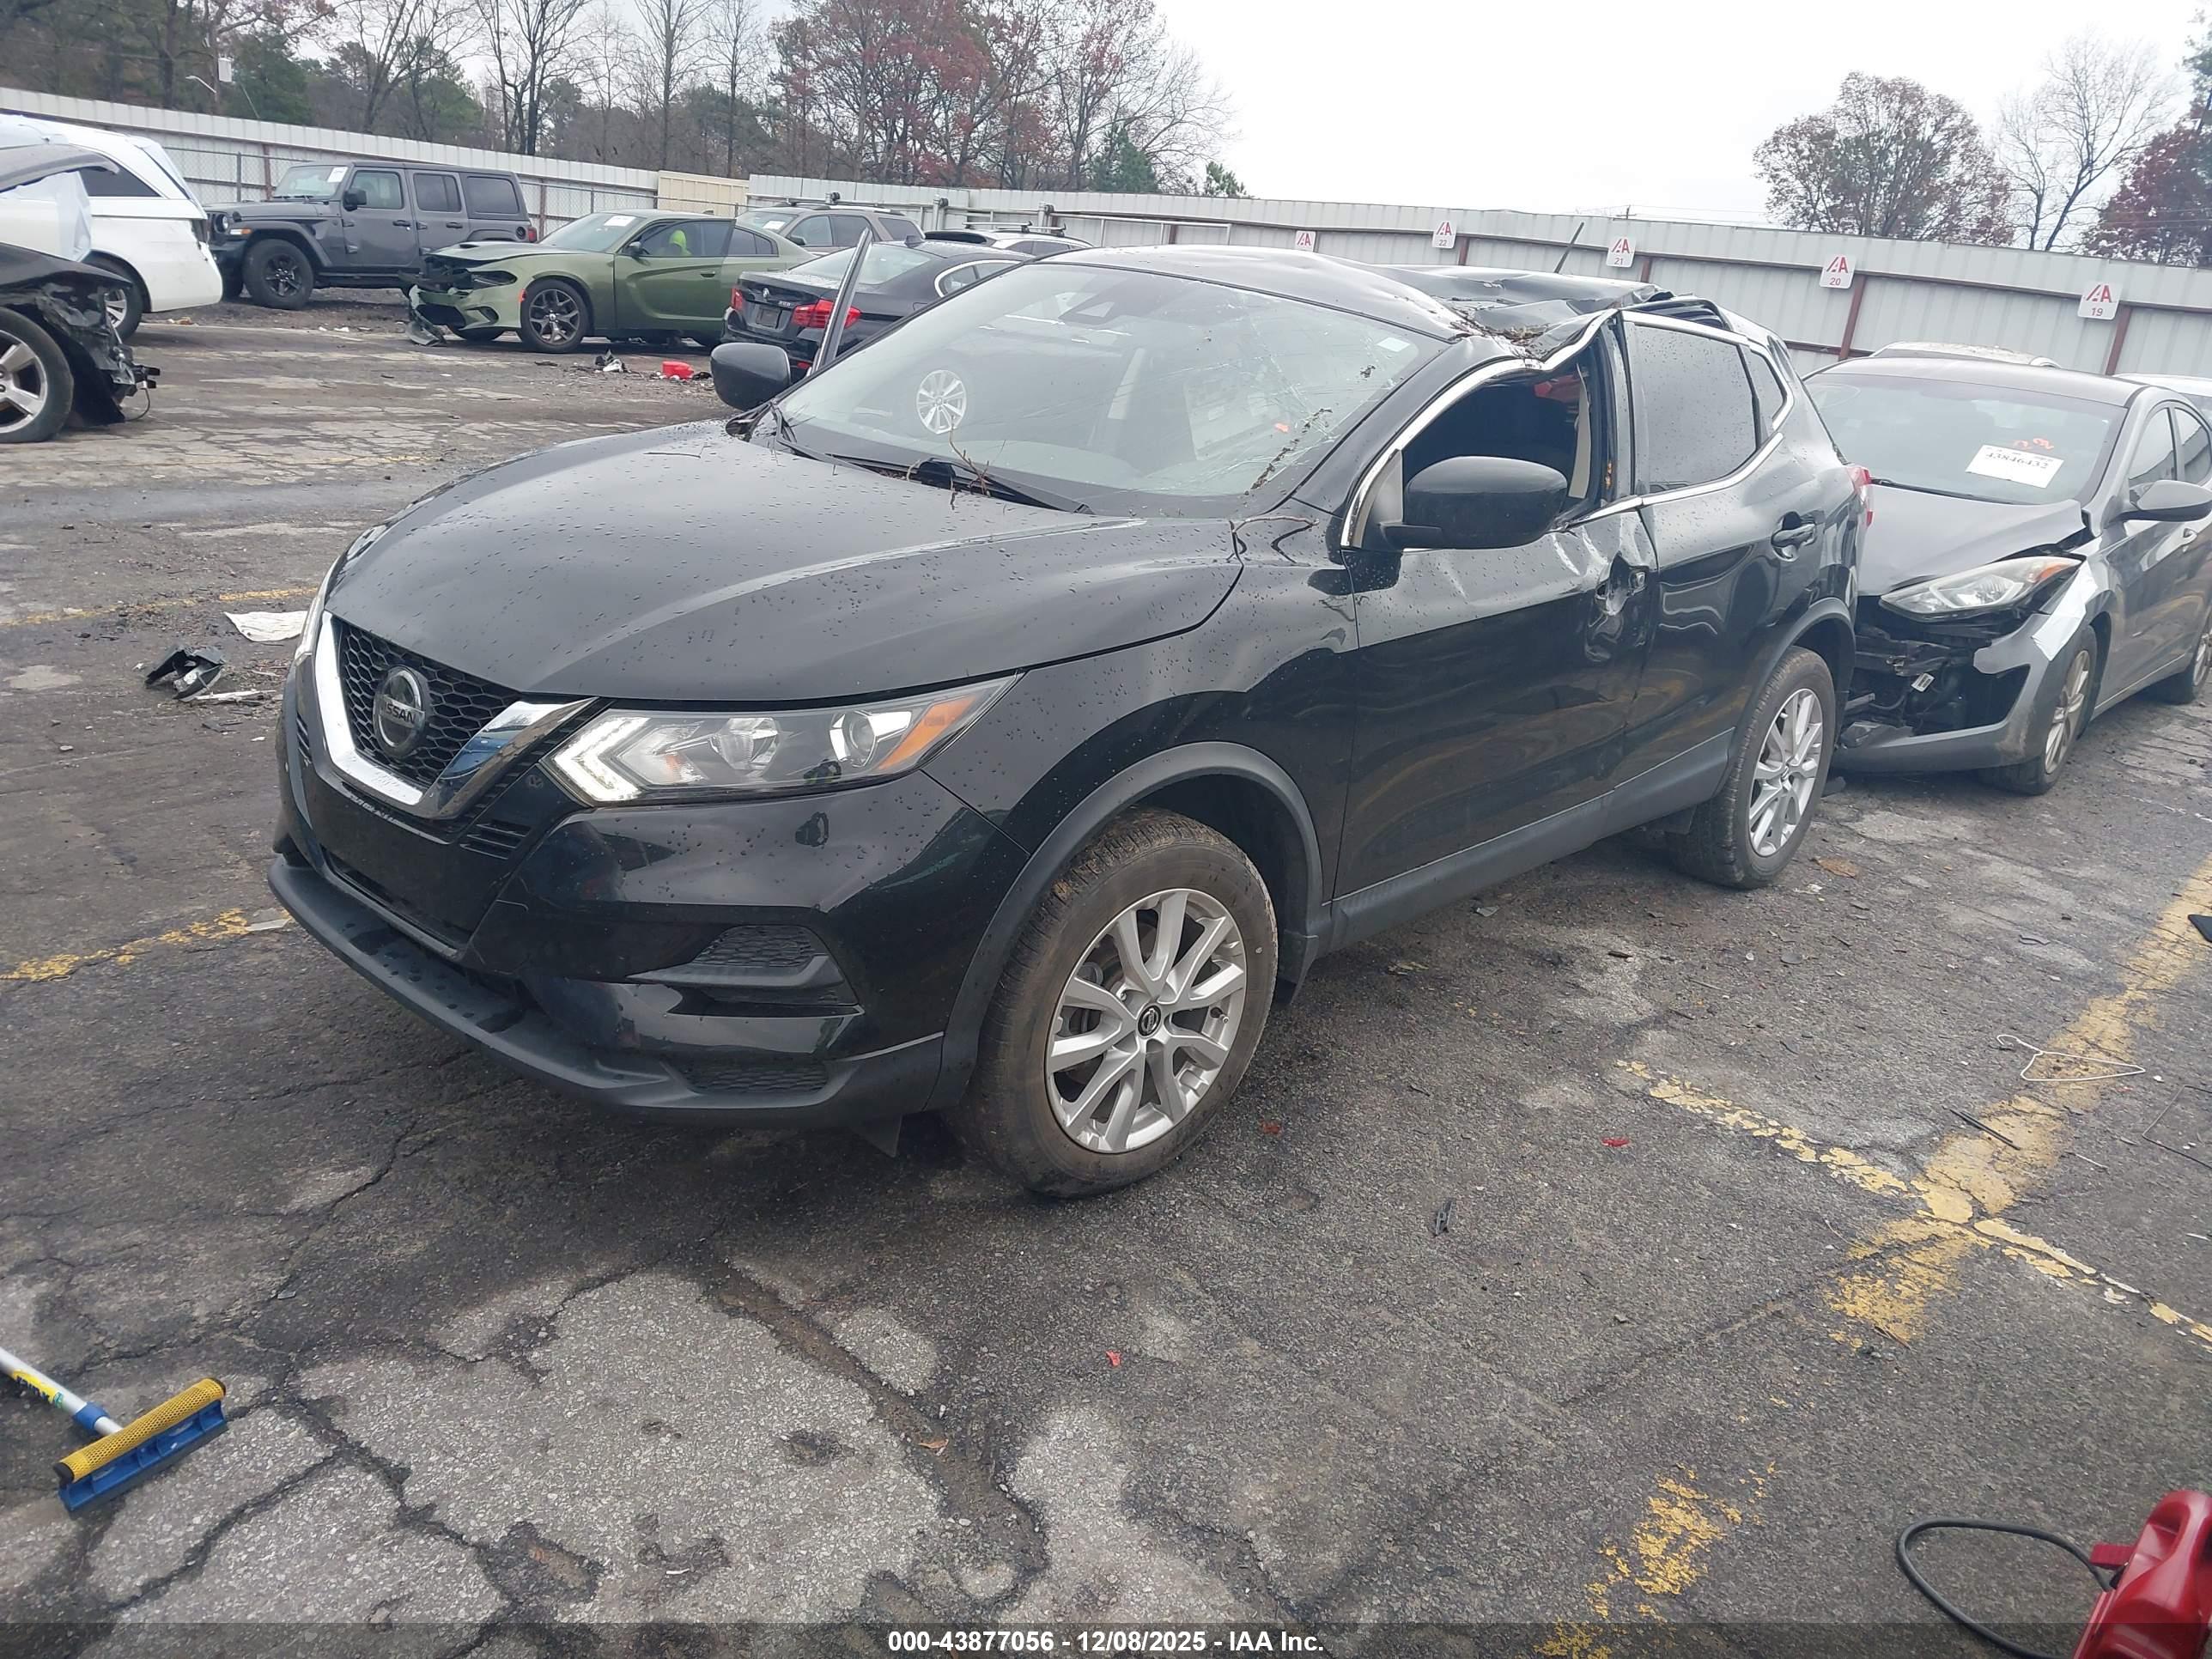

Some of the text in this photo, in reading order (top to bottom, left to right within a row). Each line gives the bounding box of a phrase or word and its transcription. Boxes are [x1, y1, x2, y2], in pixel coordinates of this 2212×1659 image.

[1614, 257, 1623, 265] 21
[1829, 277, 1841, 286] 20
[2091, 307, 2104, 317] 19
[380, 699, 416, 724] ISSAN
